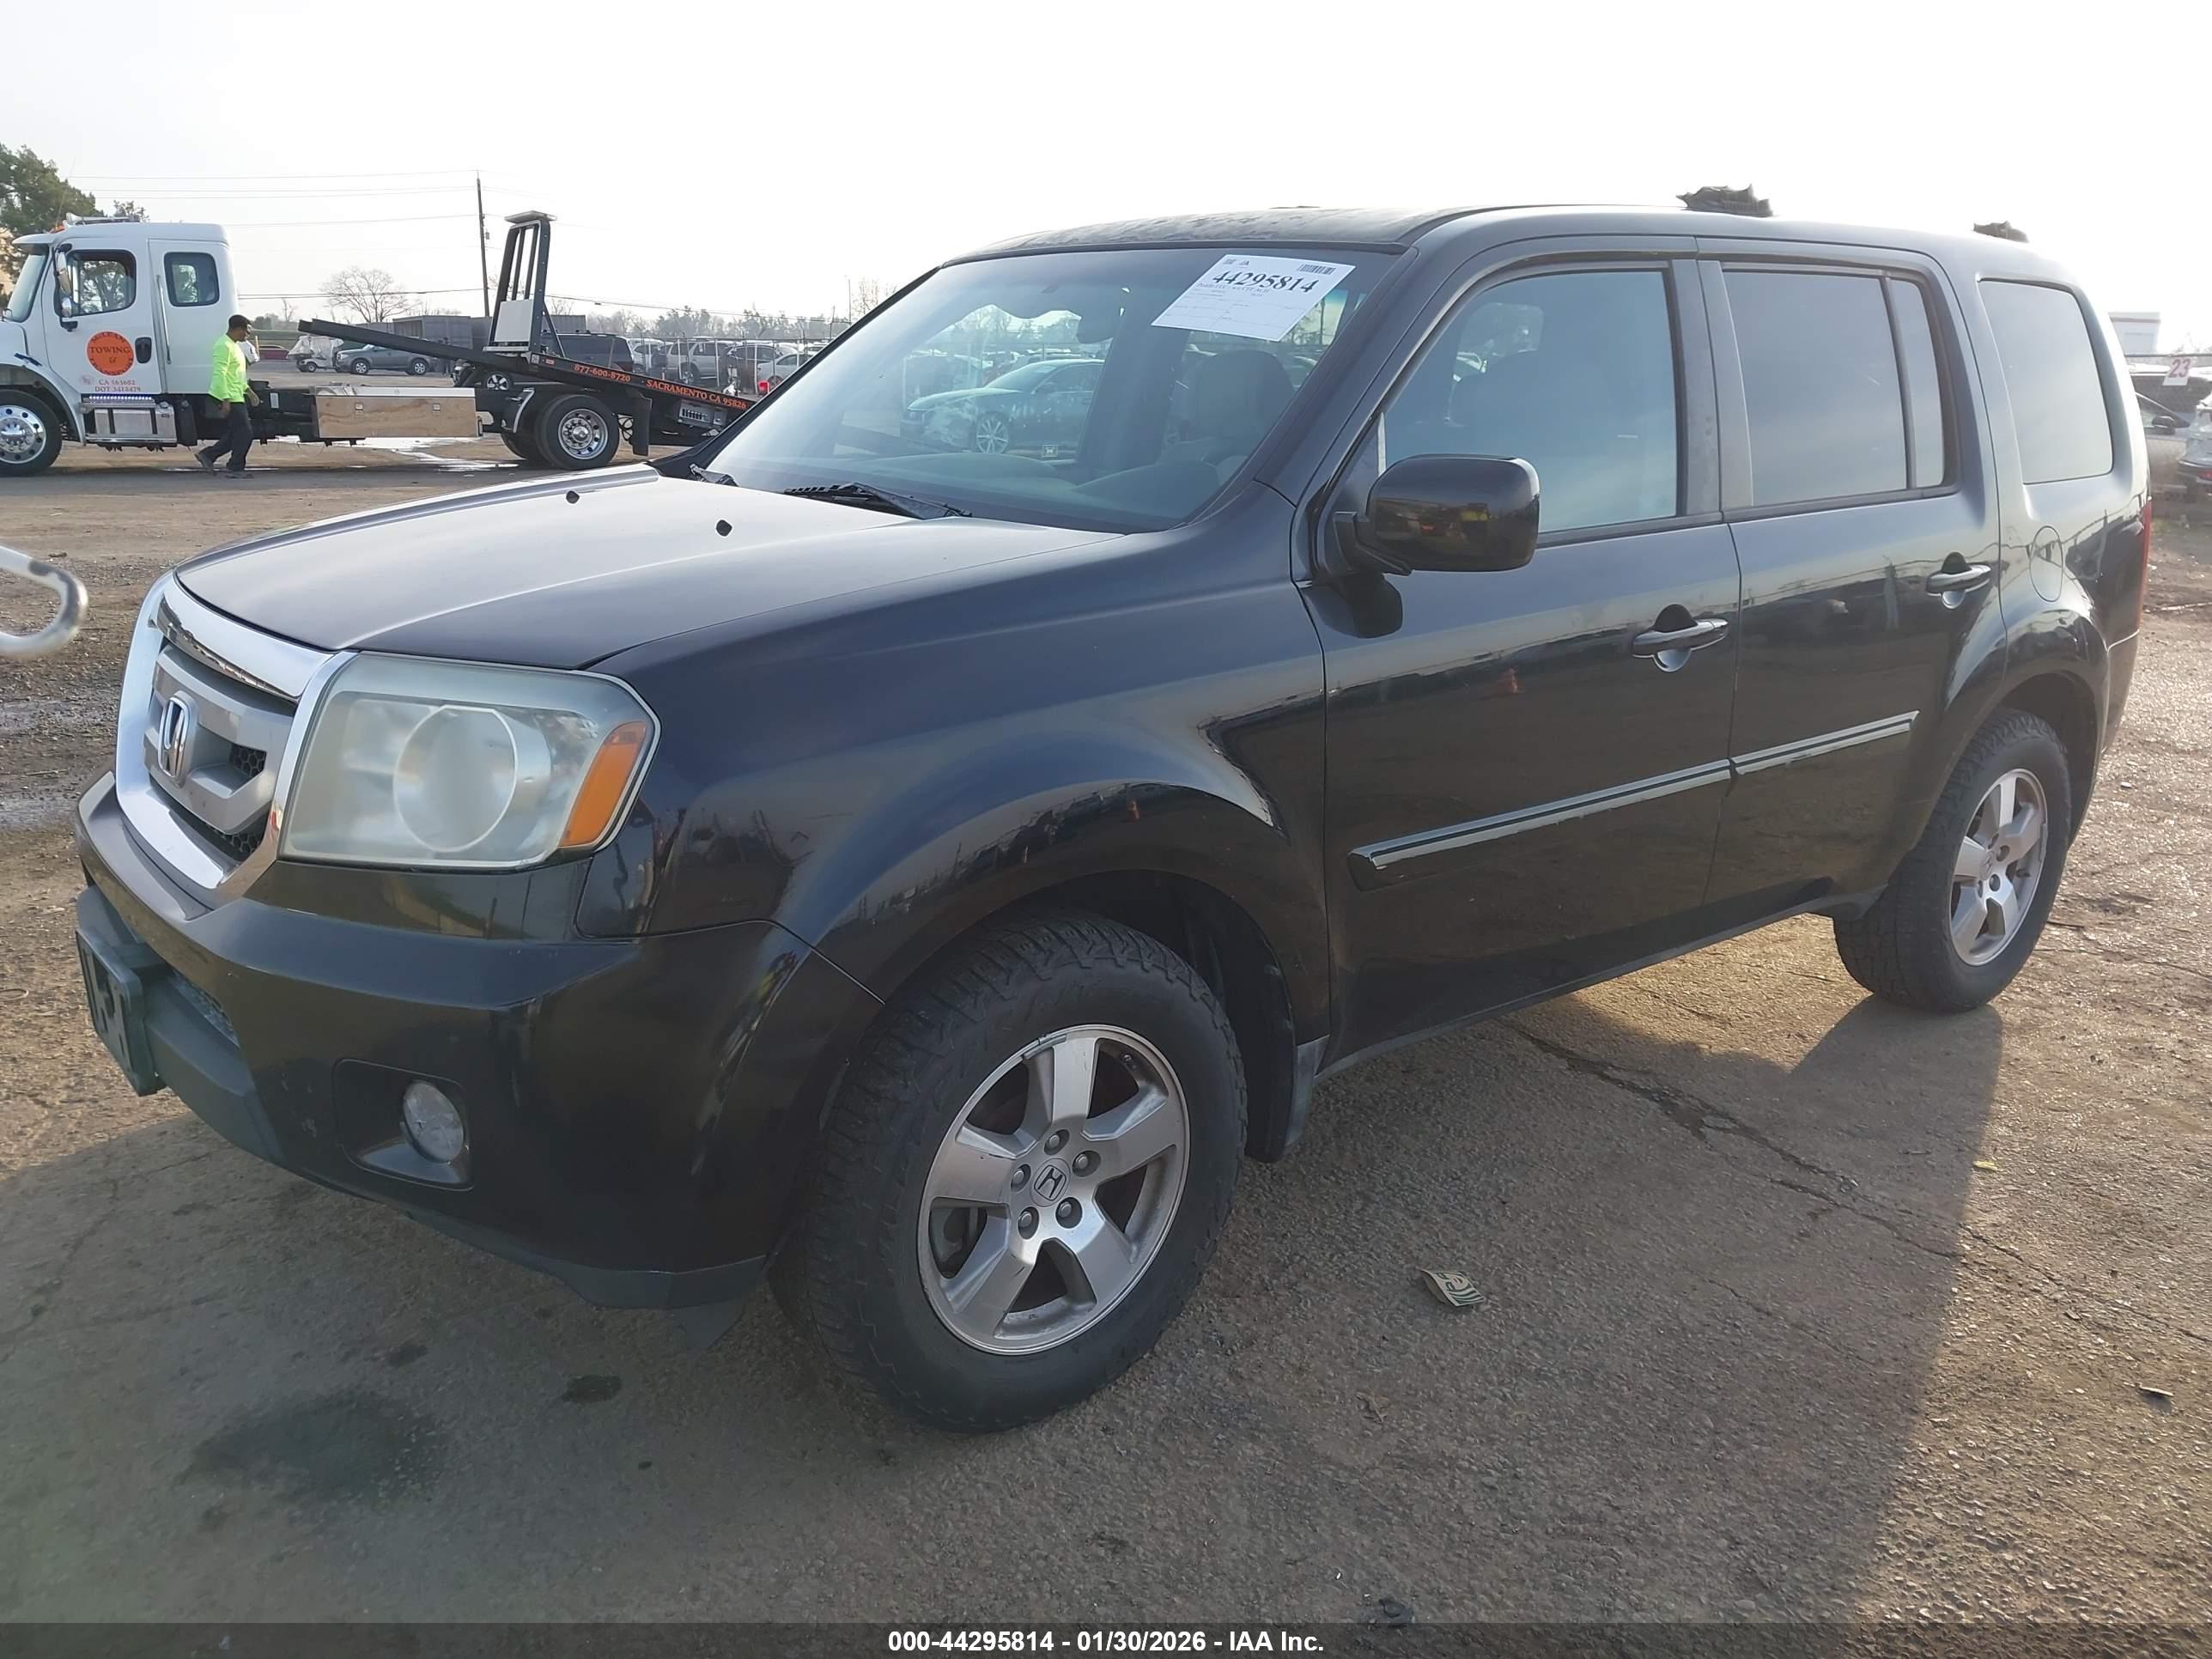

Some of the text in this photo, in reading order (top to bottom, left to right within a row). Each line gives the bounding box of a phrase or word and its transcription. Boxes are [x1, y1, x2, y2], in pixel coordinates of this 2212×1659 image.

[1212, 271, 1320, 293] 44295814
[574, 363, 631, 382] 877-600-8720
[2168, 358, 2191, 378] 23
[646, 380, 747, 410] SACRAMENTO CA 95826
